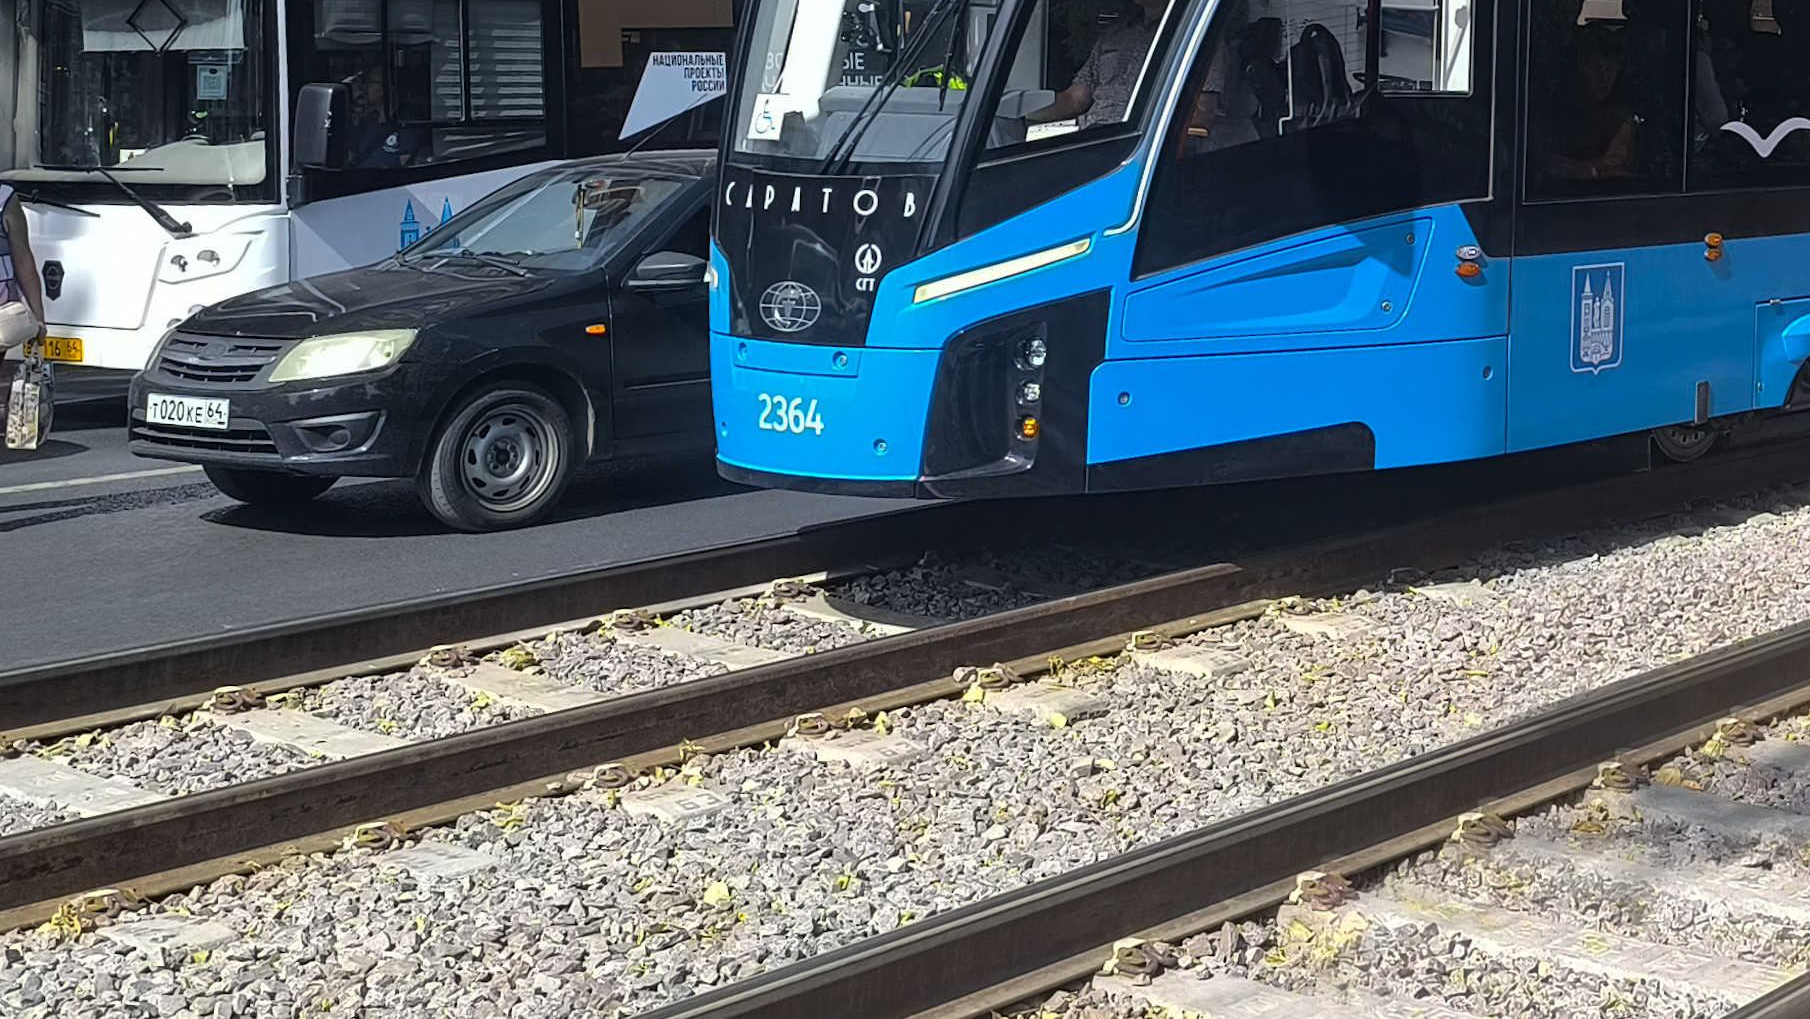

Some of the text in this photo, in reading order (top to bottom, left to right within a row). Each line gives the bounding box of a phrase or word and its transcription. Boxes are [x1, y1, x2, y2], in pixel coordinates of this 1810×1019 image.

[652, 54, 724, 67] НАЦИОНАЛЬНЫЕ
[683, 67, 725, 79] ПРОЕКТЫ
[691, 80, 725, 92] РОССИИ
[152, 399, 223, 424] Т020КЕ 64
[758, 392, 825, 436] 2364
